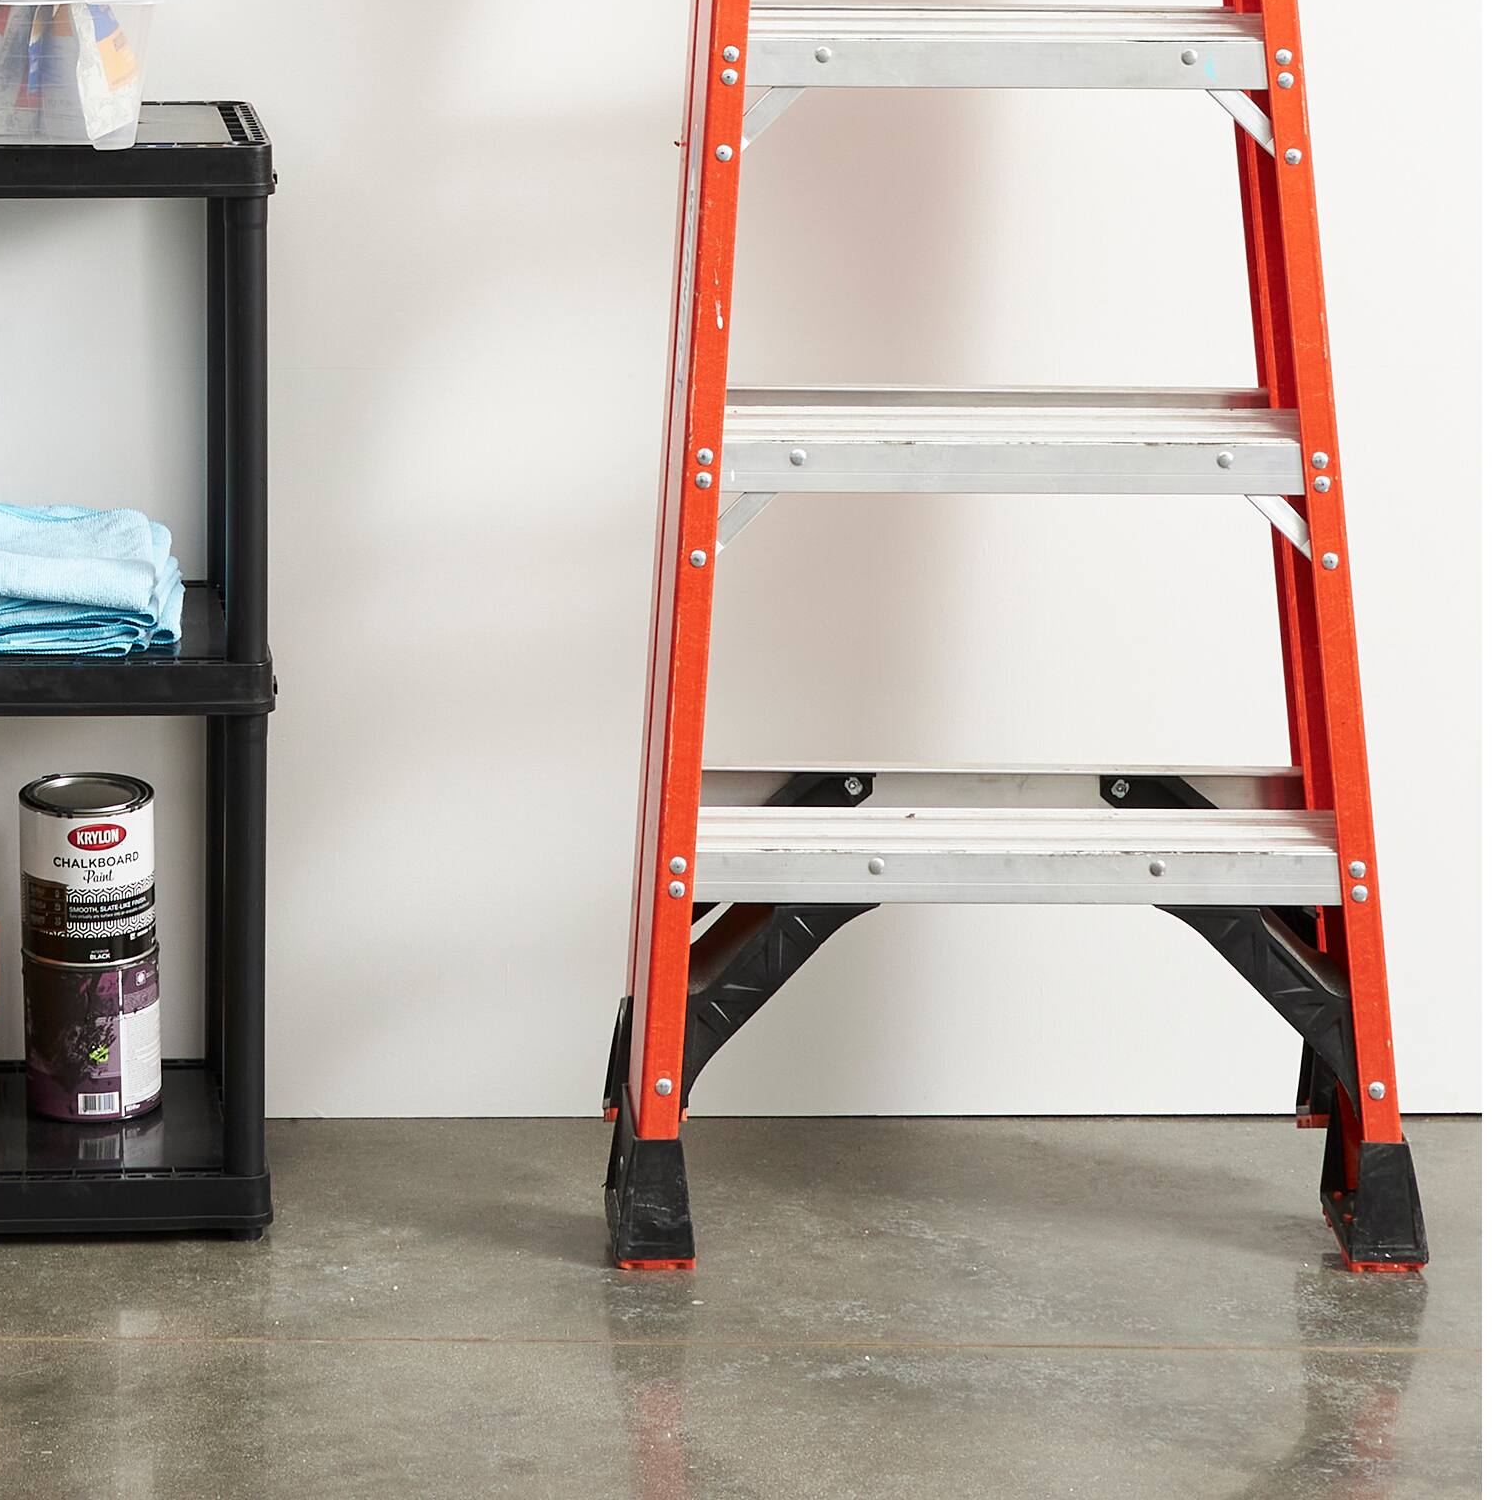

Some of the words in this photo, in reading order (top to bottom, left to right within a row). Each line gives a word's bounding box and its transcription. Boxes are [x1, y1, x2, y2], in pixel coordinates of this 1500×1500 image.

[76, 828, 120, 846] KRYLON
[52, 851, 139, 869] CHALKBOARD
[82, 869, 115, 884] Paint
[100, 900, 132, 913] SLATE-LIKE
[89, 953, 111, 961] BLACK
